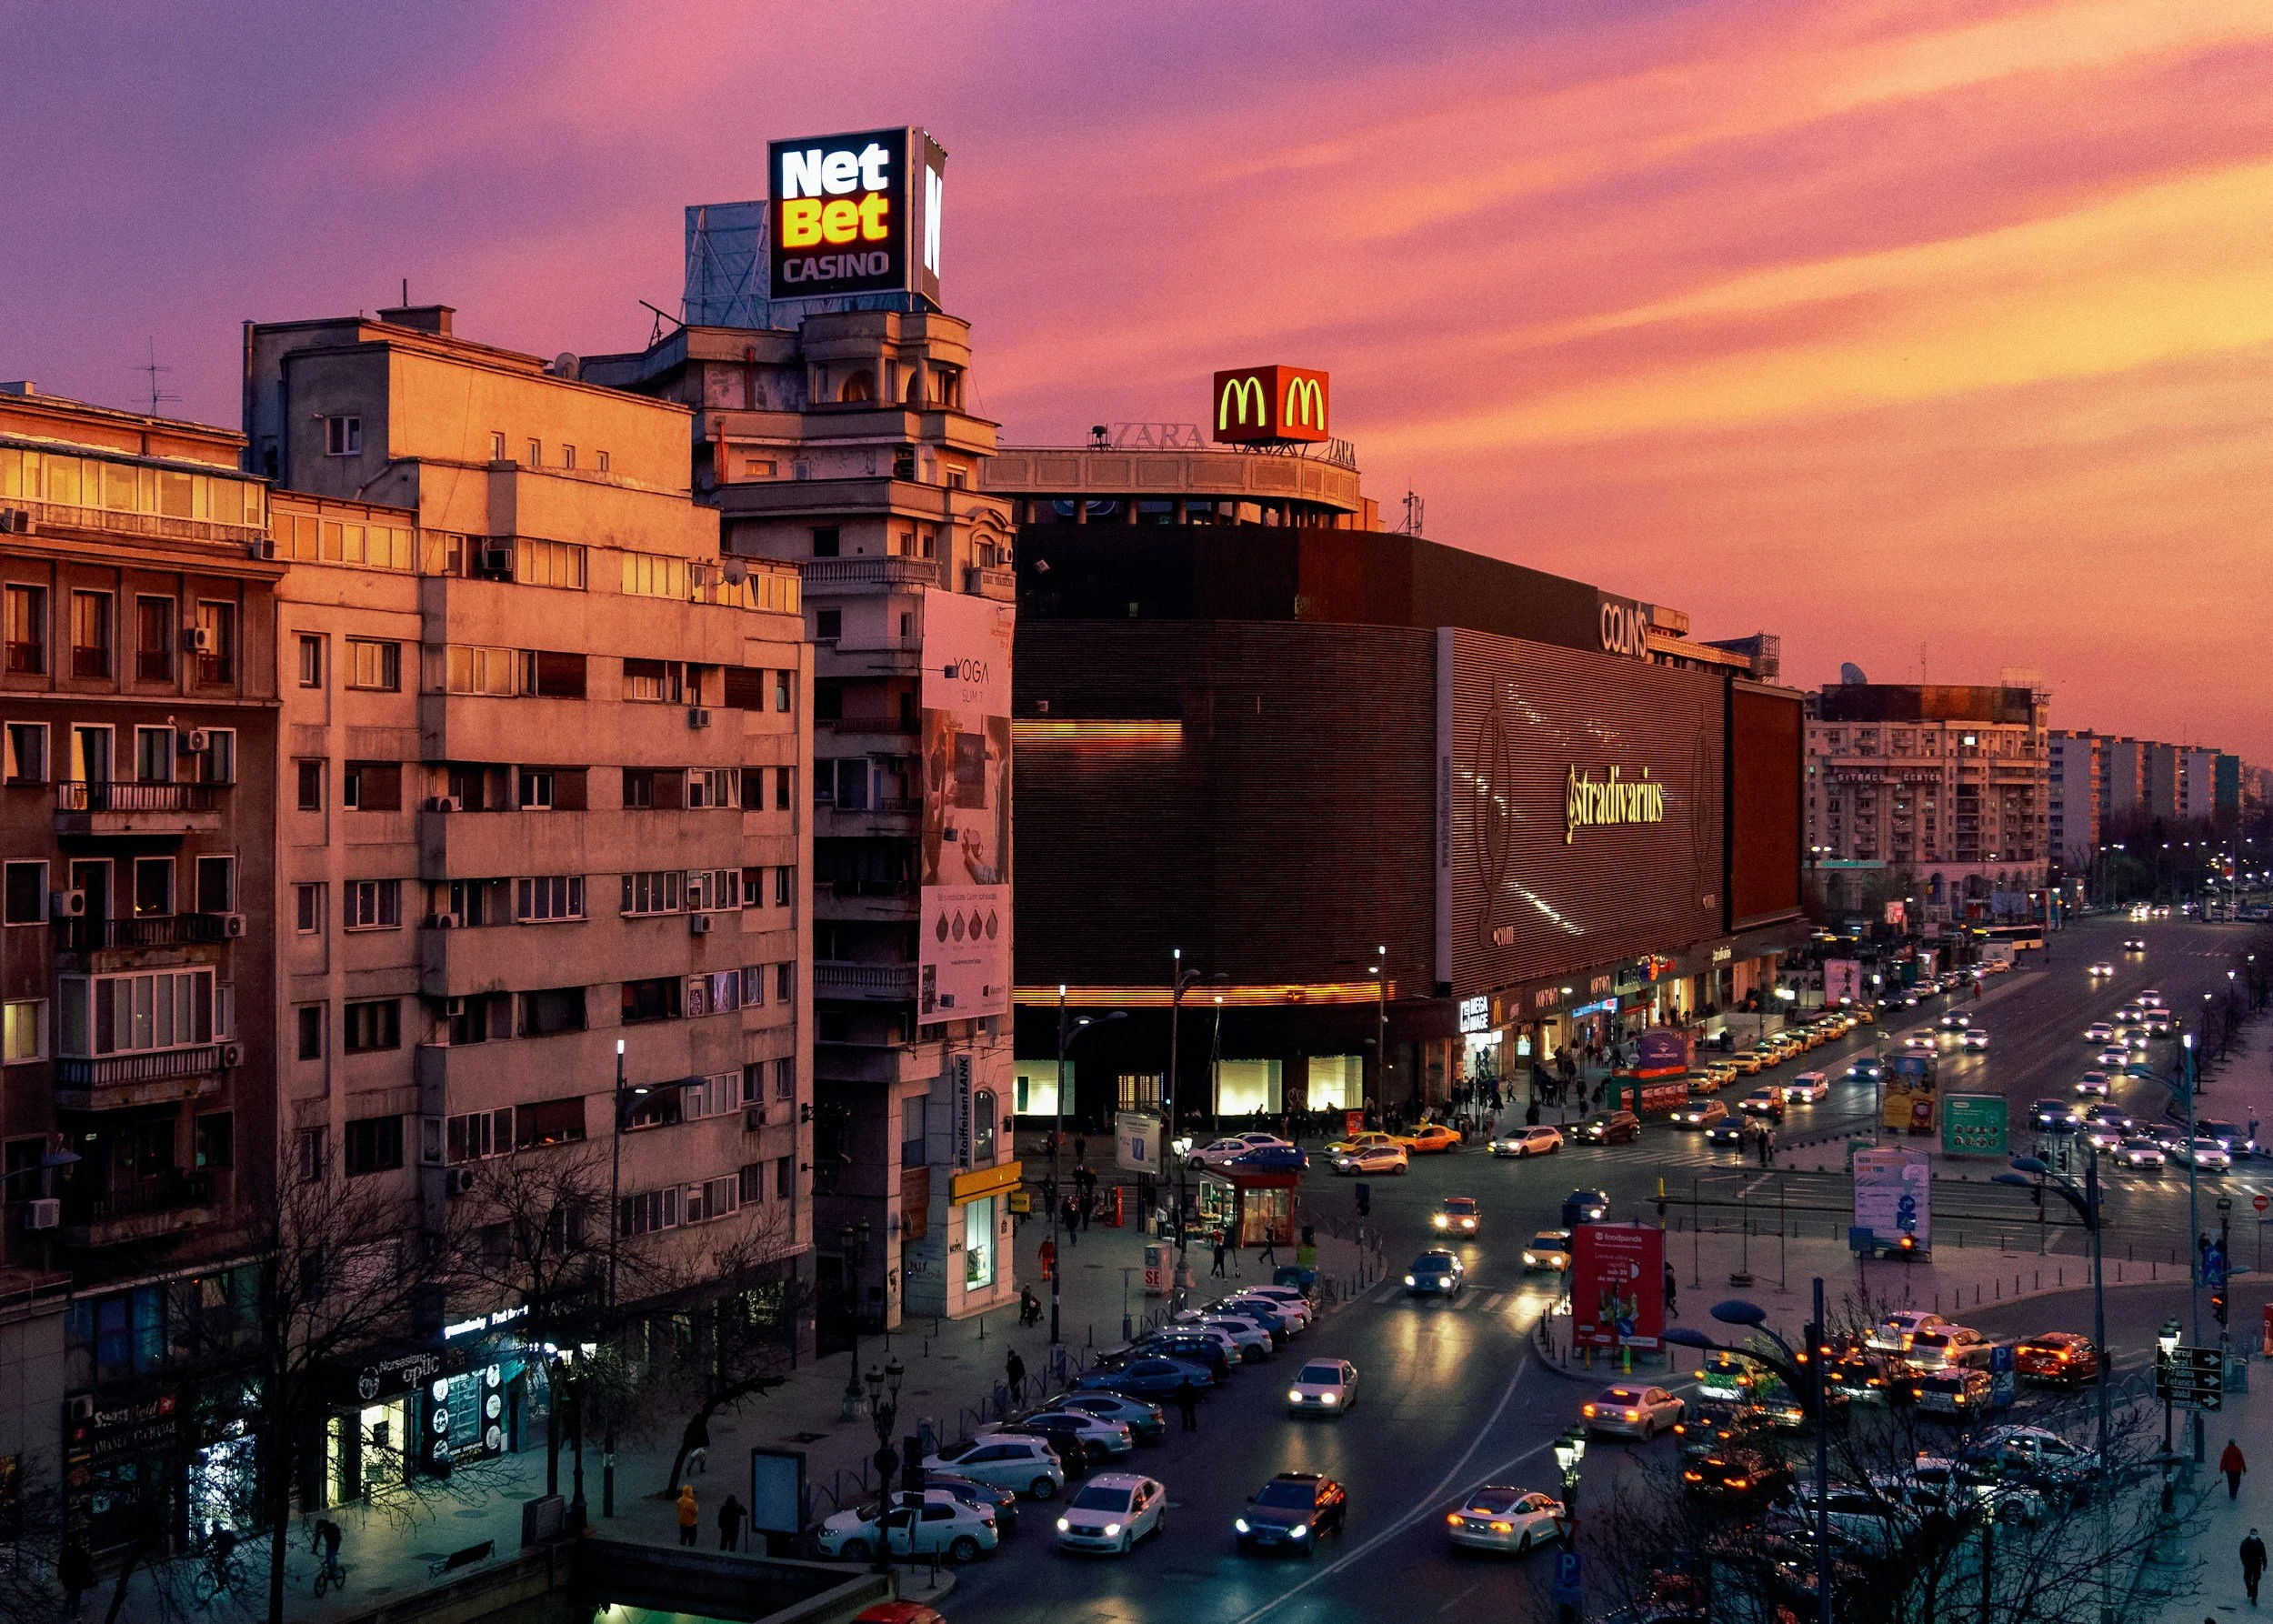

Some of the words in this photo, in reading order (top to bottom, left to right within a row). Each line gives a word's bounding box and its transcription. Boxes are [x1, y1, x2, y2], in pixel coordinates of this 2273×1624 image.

[782, 143, 889, 199] Net
[782, 192, 889, 248] Bet
[784, 251, 889, 283] CASINO
[1113, 423, 1208, 450] ZARA
[1600, 601, 1647, 657] COLIN'S
[953, 657, 989, 684] YOGA
[1567, 764, 1663, 844] stradivarius
[1469, 1013, 1488, 1032] IMAGE
[1470, 996, 1488, 1015] MEGA
[959, 1058, 969, 1095] BANK
[958, 1096, 969, 1157] Raiffeisen
[1605, 1233, 1642, 1243] foodpanda
[402, 1352, 440, 1388] optic
[1562, 1554, 1576, 1579] P
